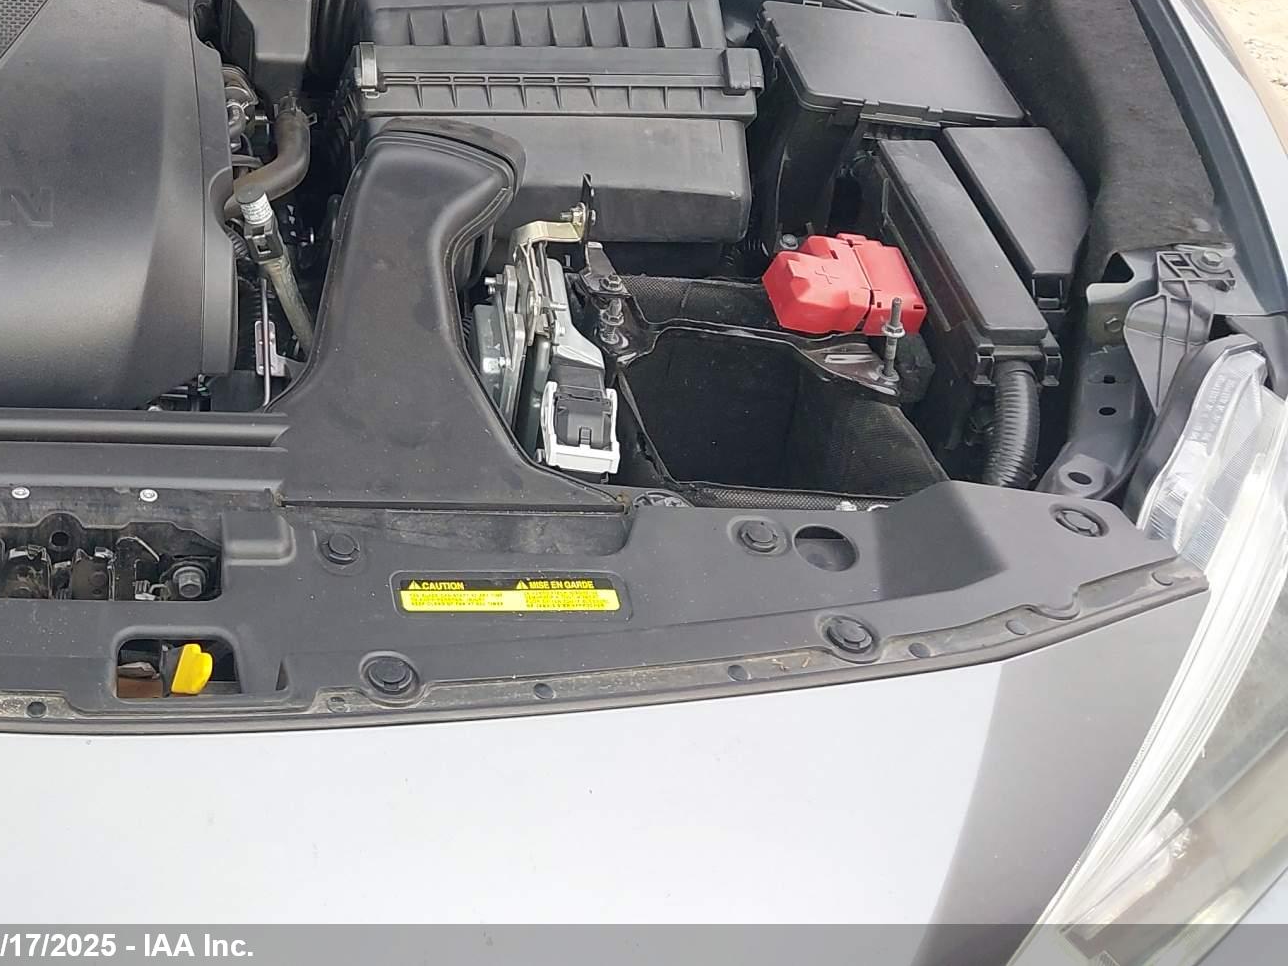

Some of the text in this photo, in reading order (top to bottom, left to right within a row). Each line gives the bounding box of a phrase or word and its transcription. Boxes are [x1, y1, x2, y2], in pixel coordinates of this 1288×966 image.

[421, 581, 465, 590] CAUTION
[528, 580, 595, 589] MISE EN GARDE
